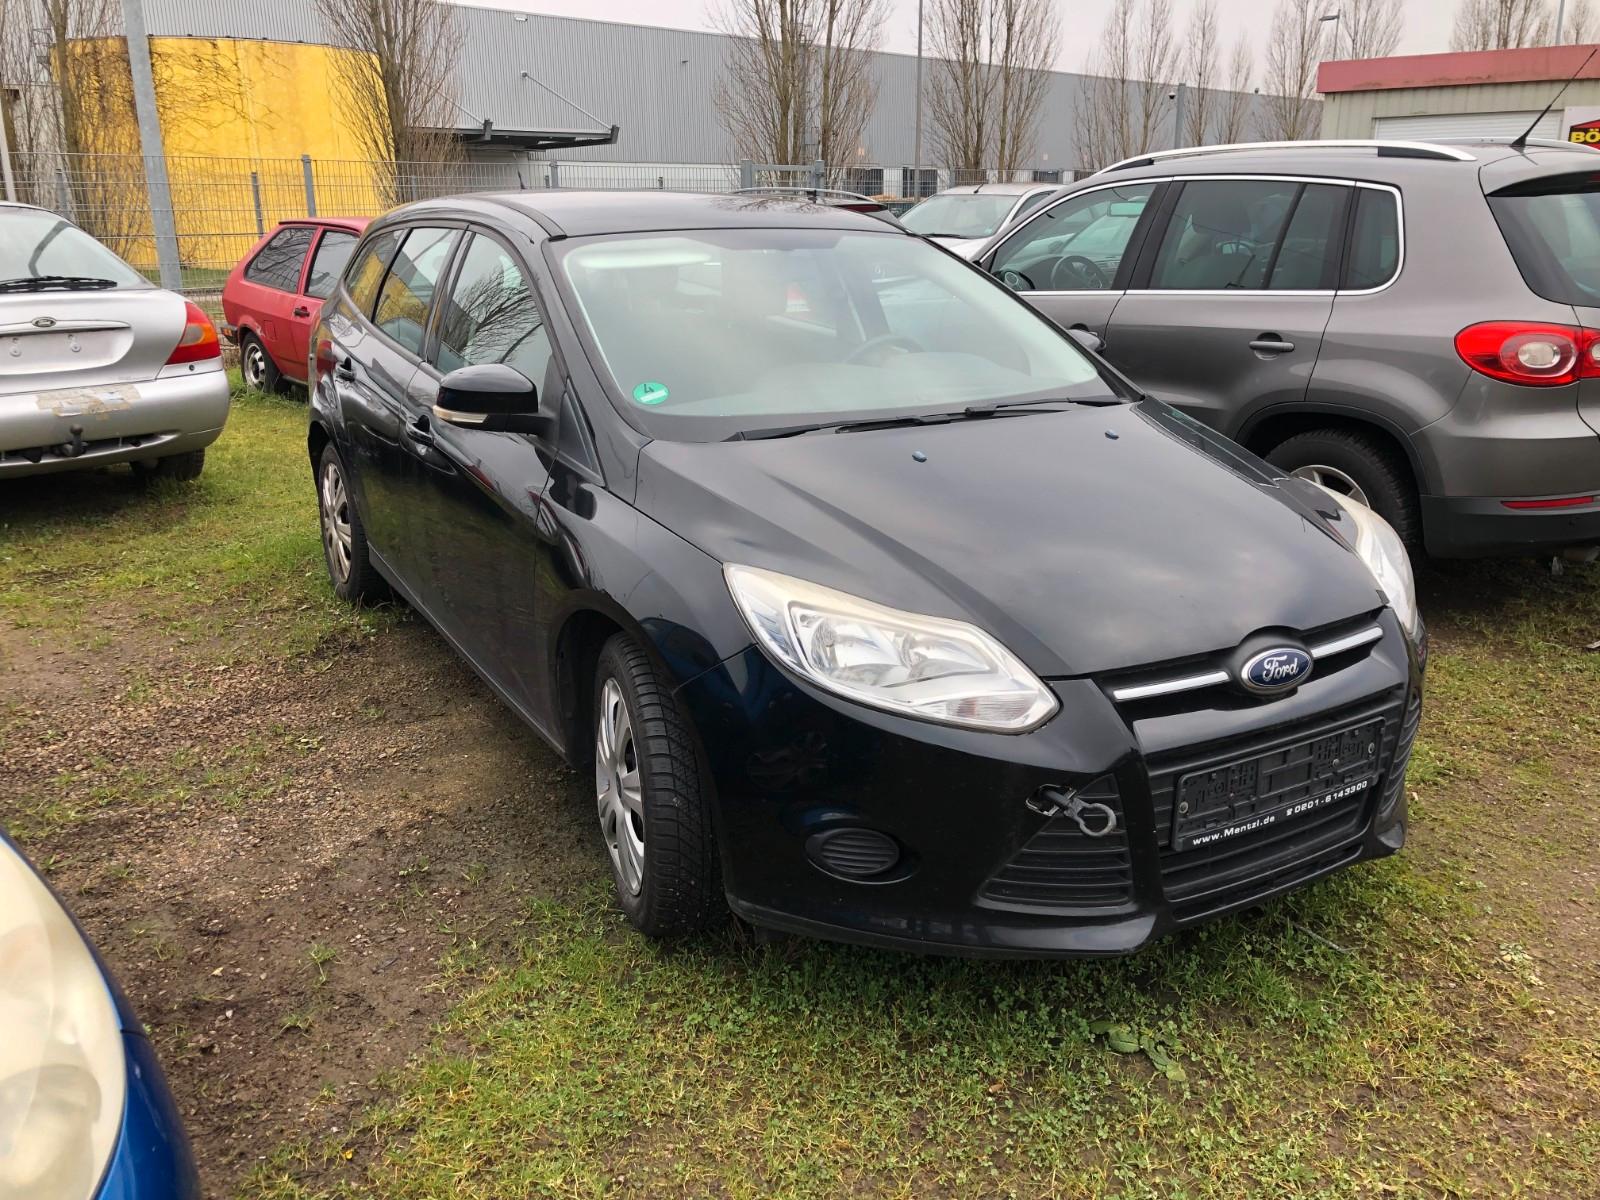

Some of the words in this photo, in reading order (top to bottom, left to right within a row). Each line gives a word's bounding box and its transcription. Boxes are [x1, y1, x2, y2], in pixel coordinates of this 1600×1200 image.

[1570, 128, 1600, 142] BÖ
[1262, 655, 1299, 682] Ford
[1192, 815, 1276, 846] www.Mentzl.de
